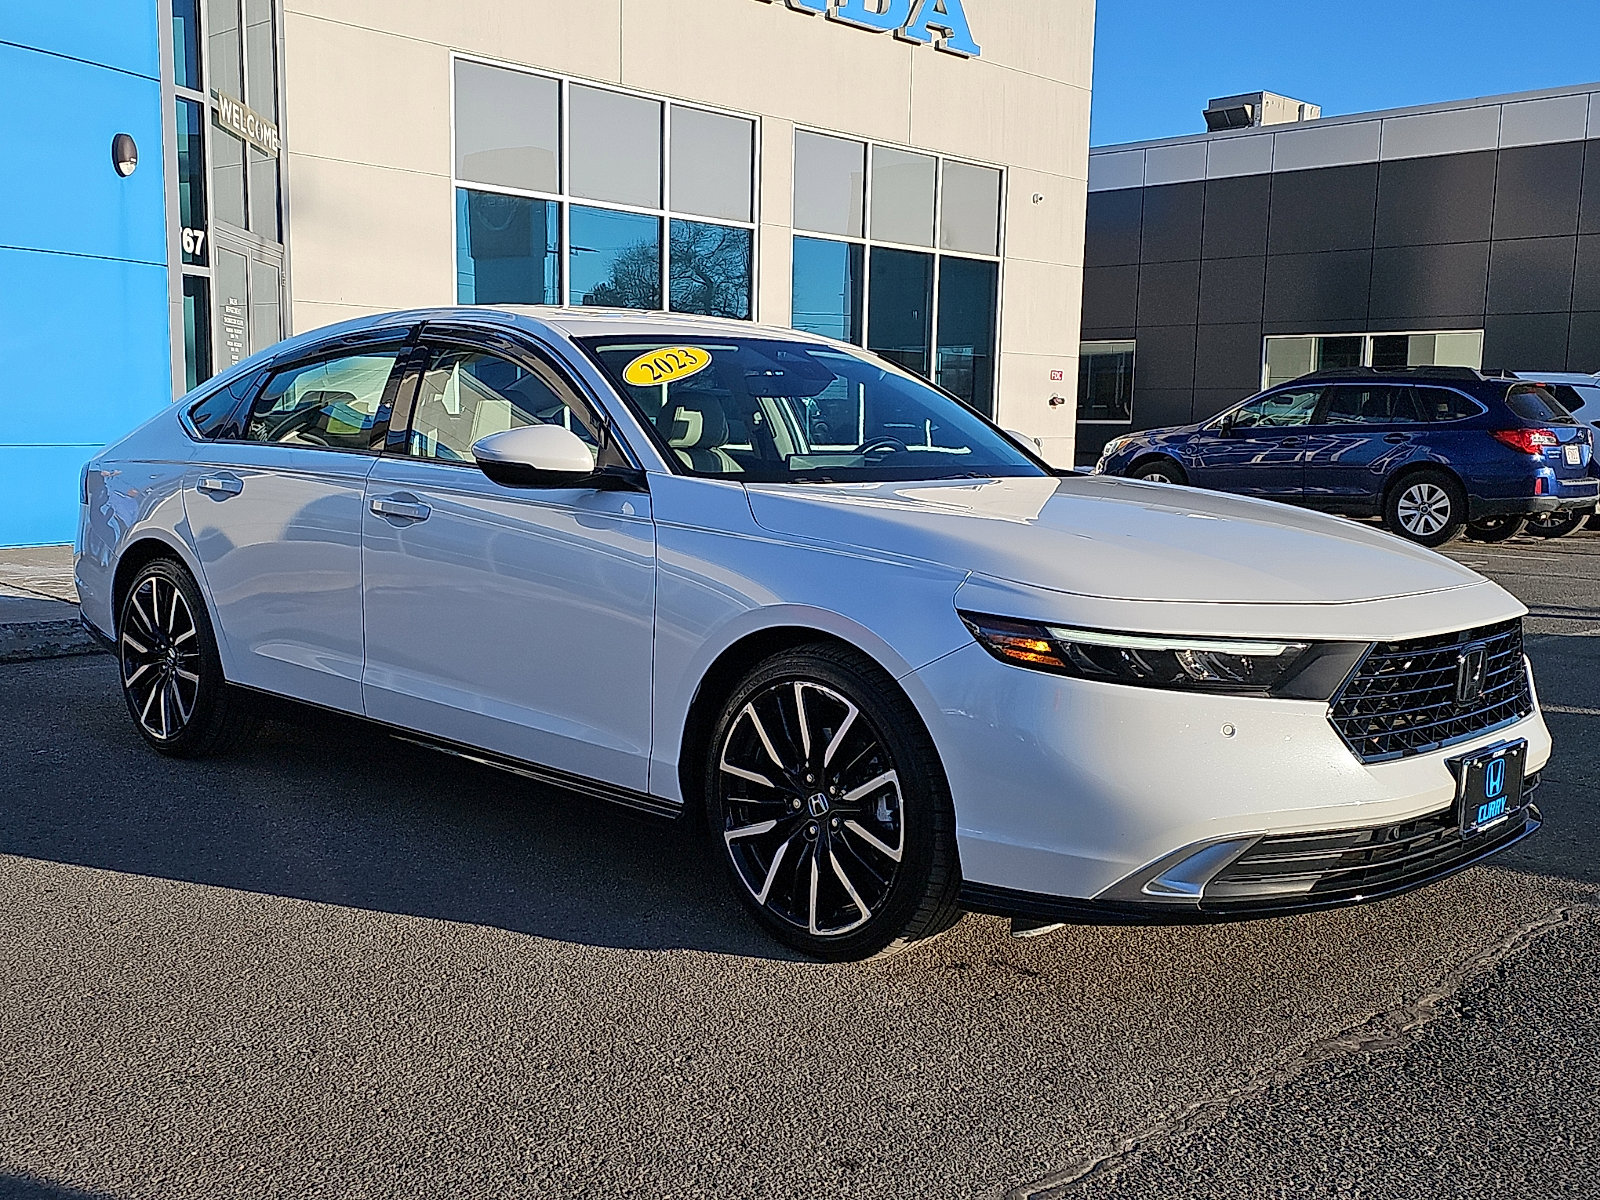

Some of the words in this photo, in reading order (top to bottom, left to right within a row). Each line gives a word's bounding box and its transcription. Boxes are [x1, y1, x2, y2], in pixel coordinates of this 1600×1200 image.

[219, 94, 278, 153] WELCOME
[180, 226, 205, 256] 67
[640, 349, 698, 381] 2023
[1477, 795, 1508, 823] CURRY
